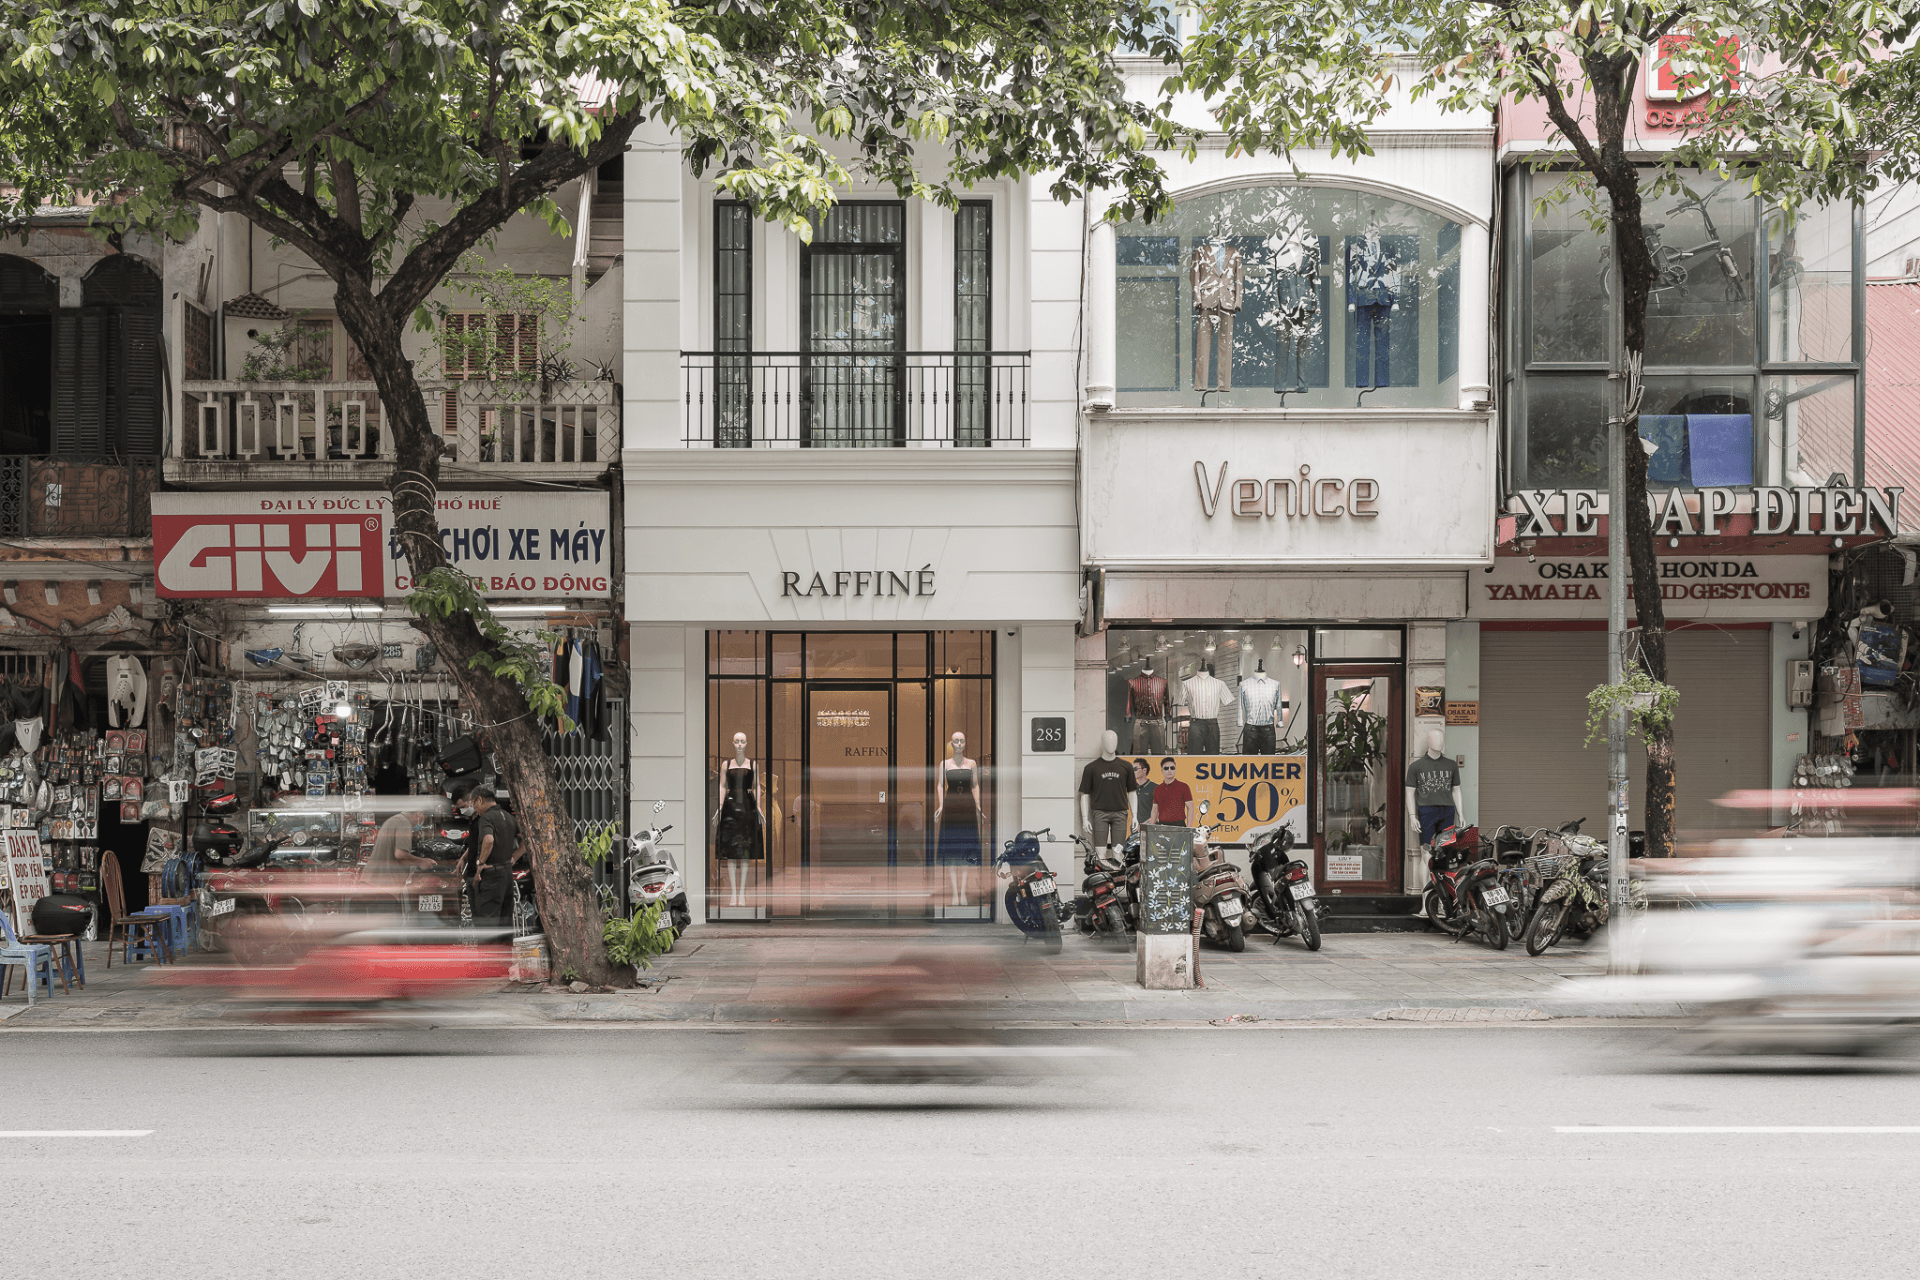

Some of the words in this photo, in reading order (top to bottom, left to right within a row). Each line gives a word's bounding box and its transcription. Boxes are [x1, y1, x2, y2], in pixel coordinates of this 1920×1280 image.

[1194, 461, 1380, 518] Venice
[260, 500, 292, 512] ĐẠI
[297, 497, 317, 510] LÝ
[323, 497, 361, 510] ĐỨC
[434, 495, 463, 510] HỐ
[468, 496, 503, 510] HUẾ
[1518, 487, 1599, 538] XE
[1751, 472, 1905, 549] ĐIỆN
[508, 528, 541, 560] XE
[550, 521, 606, 565] MÁY
[158, 523, 363, 595] GIVI
[1660, 561, 1759, 578] HONDA
[491, 573, 536, 591] BÁO
[543, 573, 608, 596] ĐỘNG
[781, 563, 937, 597] RAFFINÉ
[1485, 584, 1602, 600] YAMAHA
[383, 645, 402, 657] 285
[1420, 696, 1442, 708] 287
[1036, 728, 1062, 742] 285
[1195, 763, 1301, 780] SUMMER
[1216, 781, 1298, 822] 50%
[27, 836, 39, 857] XE
